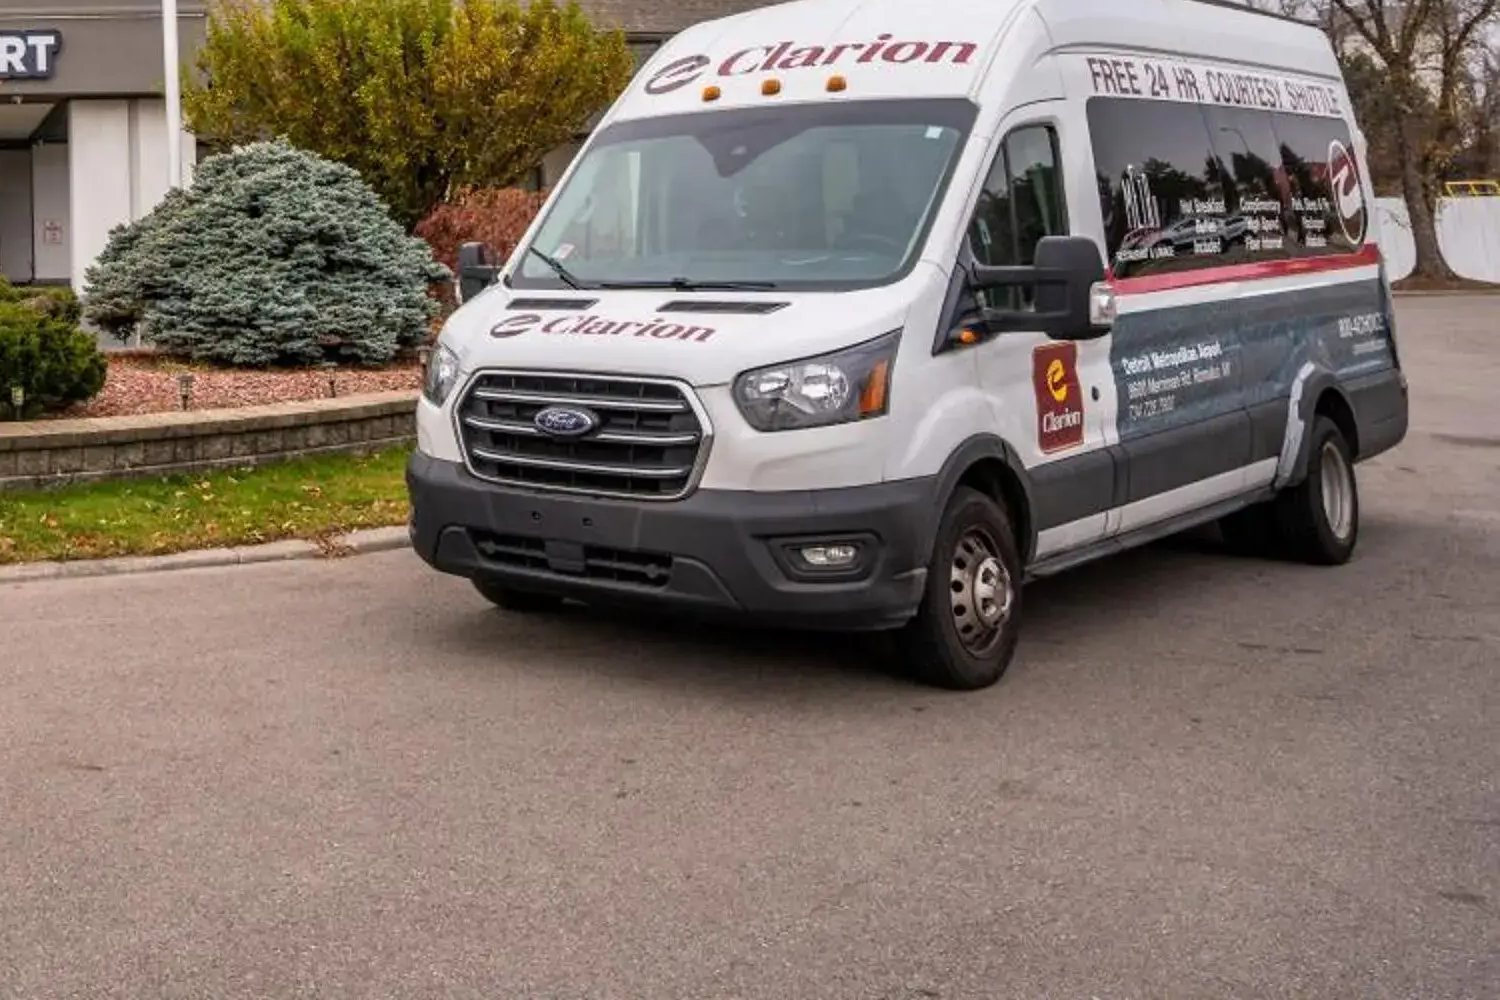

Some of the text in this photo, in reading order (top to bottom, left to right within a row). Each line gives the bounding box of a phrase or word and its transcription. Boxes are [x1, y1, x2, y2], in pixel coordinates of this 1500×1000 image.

[717, 33, 978, 77] Clarion
[1086, 57, 1142, 95] FREE
[1143, 62, 1169, 98] 24
[1206, 69, 1283, 108] COURTESY
[1284, 79, 1341, 114] SHUTTLE
[541, 314, 716, 342] Clarion
[1043, 407, 1081, 433] Clarion
